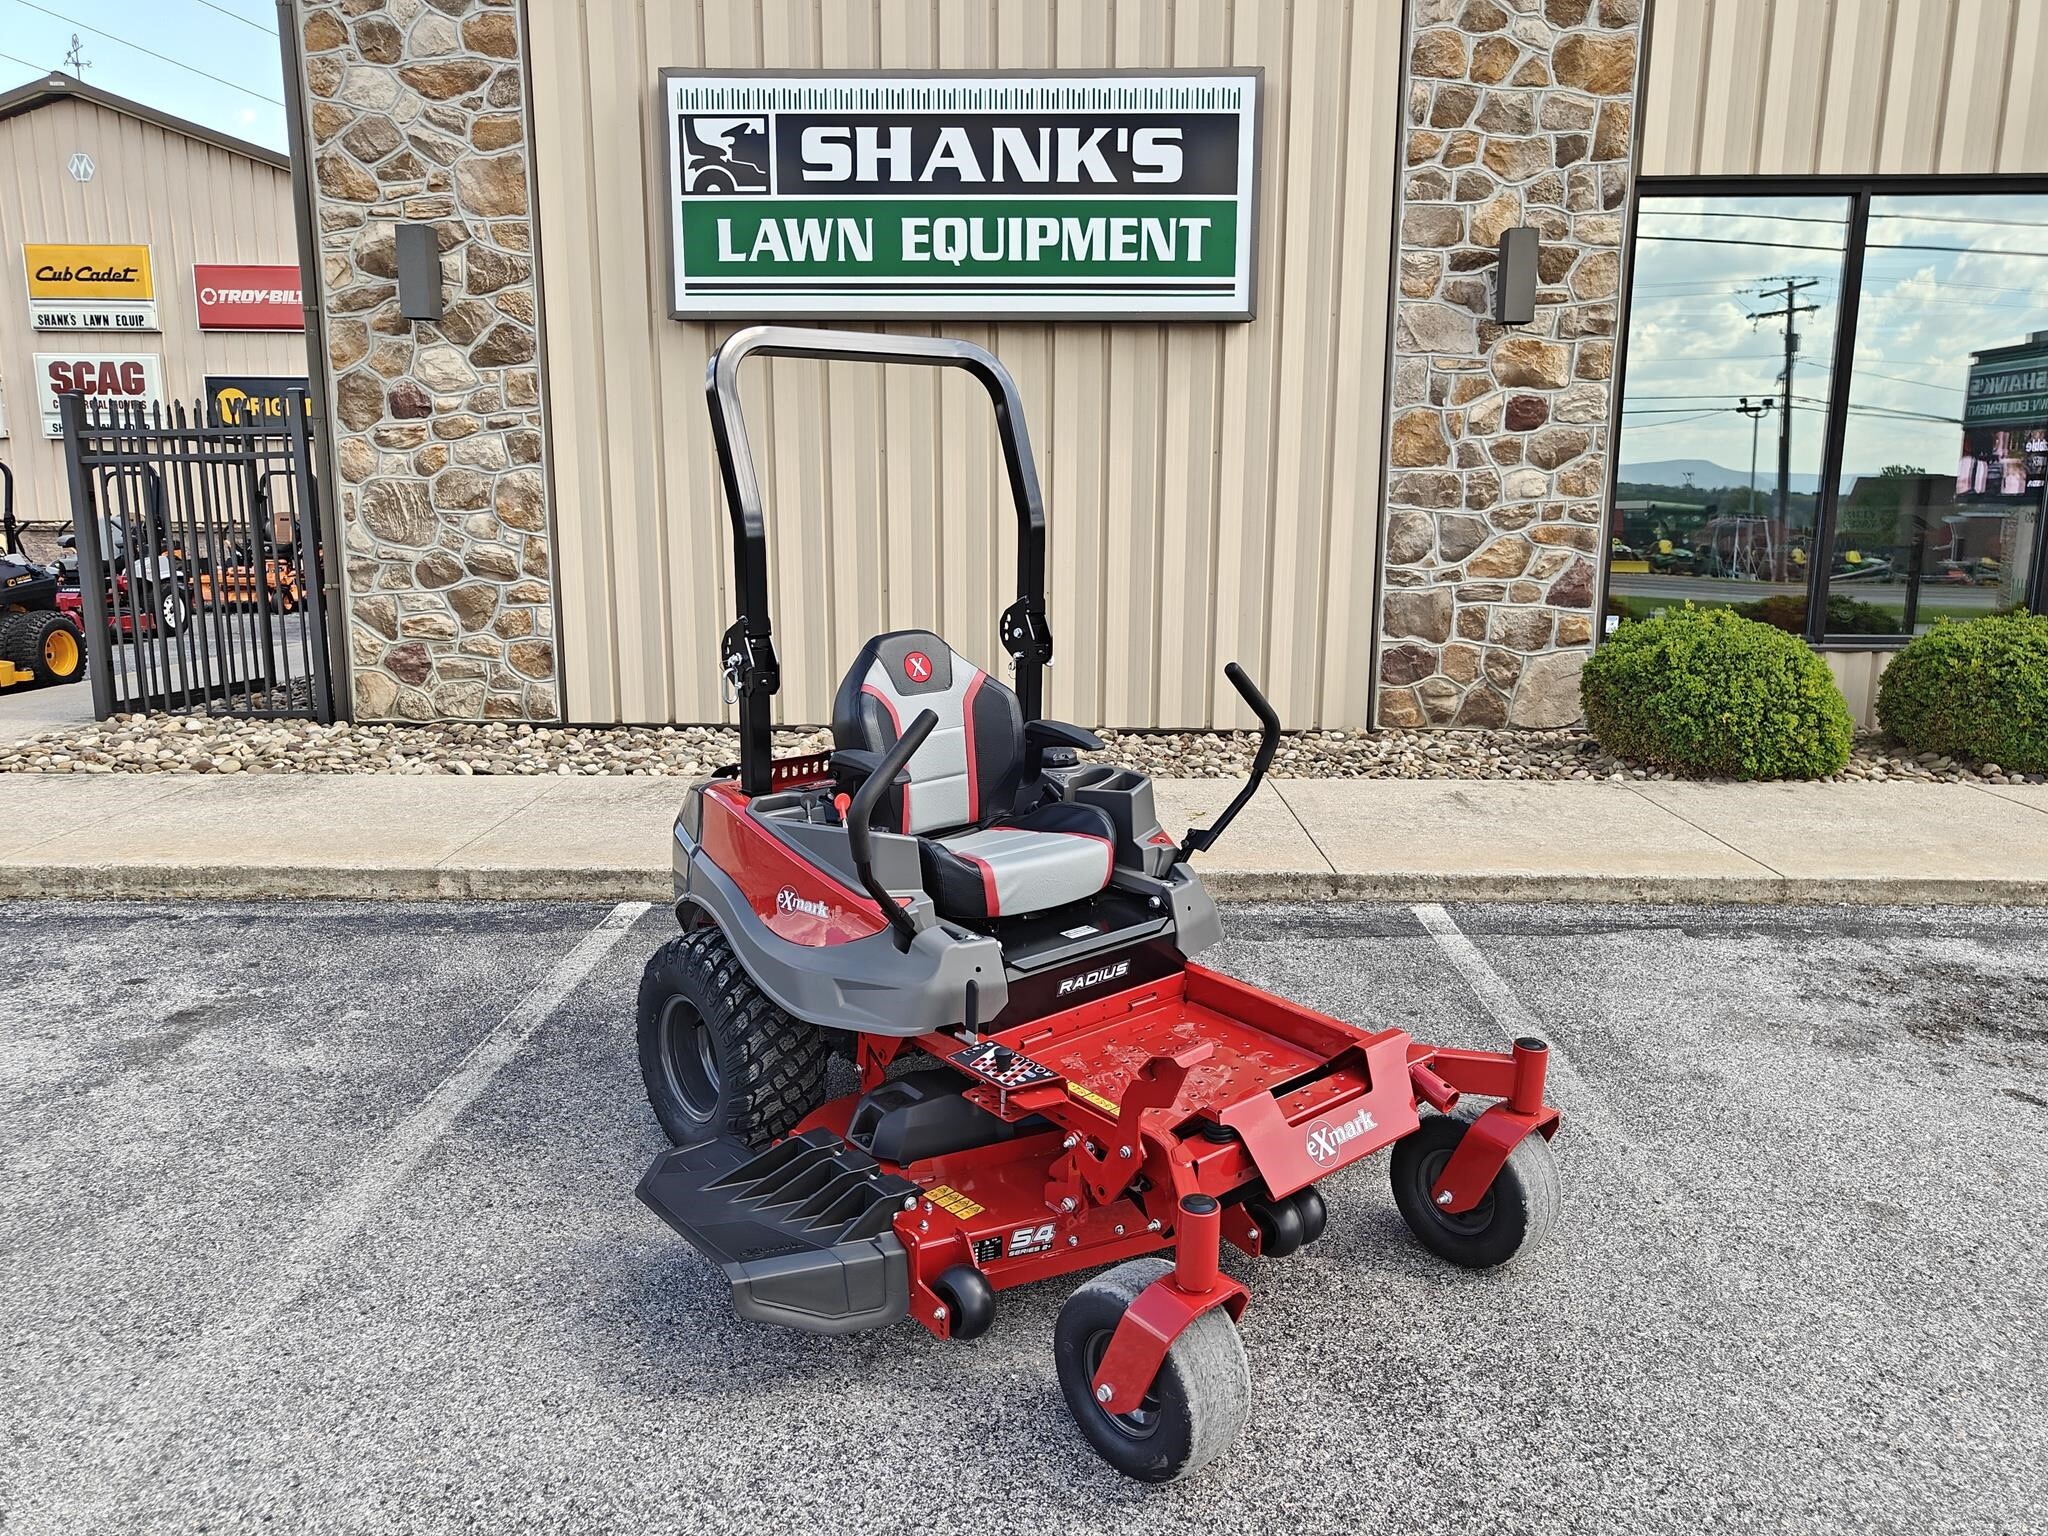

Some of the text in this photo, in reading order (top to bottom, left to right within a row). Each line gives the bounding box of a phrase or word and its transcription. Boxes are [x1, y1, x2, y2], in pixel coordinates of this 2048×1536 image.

[801, 126, 1184, 184] SHANK'S
[717, 217, 1212, 267] LAWN EQUIPMENT
[35, 266, 138, 282] Cub Cadet
[37, 313, 77, 326] SHANK'S
[83, 314, 110, 327] LAWN
[48, 361, 146, 396] SCAG
[776, 889, 830, 919] eXmark
[1058, 961, 1130, 996] RADIUS
[1307, 1108, 1378, 1162] eXmark
[1009, 1223, 1056, 1251] 54
